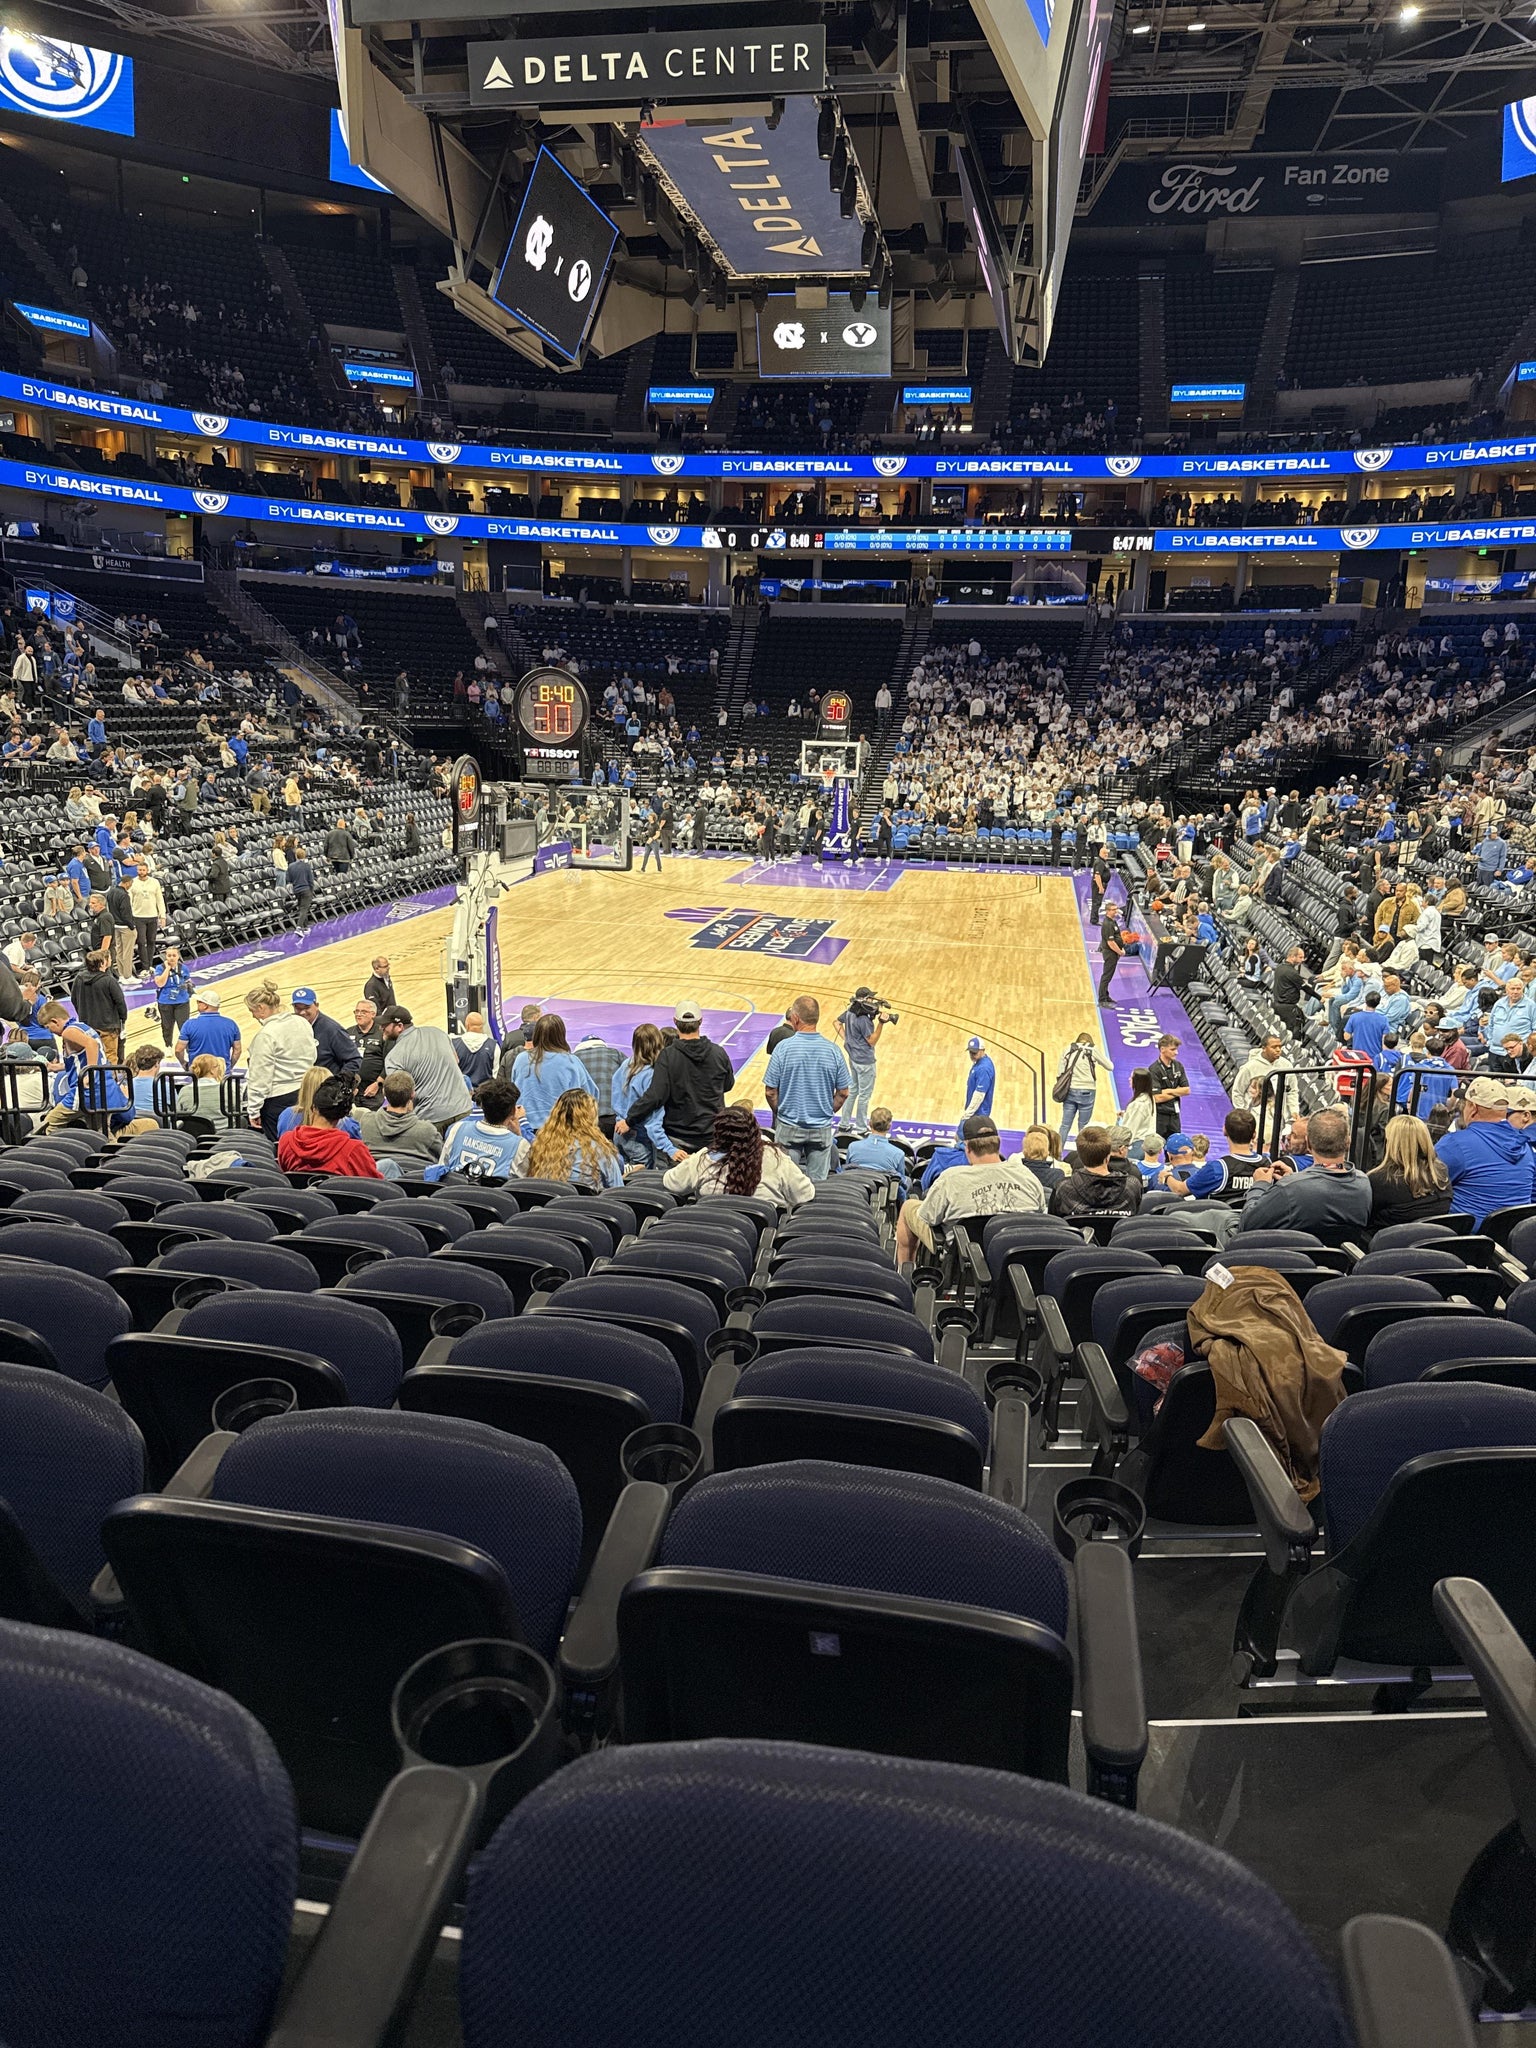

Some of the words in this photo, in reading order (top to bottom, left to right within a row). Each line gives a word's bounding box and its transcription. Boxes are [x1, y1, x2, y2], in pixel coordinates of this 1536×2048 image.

[524, 51, 648, 84] DELTA
[665, 43, 810, 78] CENTER
[701, 126, 803, 233] DELTA
[1284, 164, 1327, 186] Fan
[1331, 163, 1390, 185] Zone
[1147, 163, 1265, 214] Ford
[728, 533, 737, 548] 0
[750, 533, 760, 548] 0
[790, 533, 810, 548] 8:40
[1113, 536, 1135, 550] 6:47
[1137, 536, 1153, 550] PM
[105, 559, 131, 568] HEALTH
[540, 685, 574, 703] 8:40
[533, 703, 571, 735] 30
[539, 749, 580, 759] TISSOT
[494, 985, 506, 1041] MERICA
[892, 1126, 957, 1137] ERSITY
[463, 1136, 503, 1158] HANSBROUGH
[971, 1184, 993, 1199] HOLY
[996, 1182, 1021, 1191] WAR
[1232, 1176, 1254, 1190] DYBA
